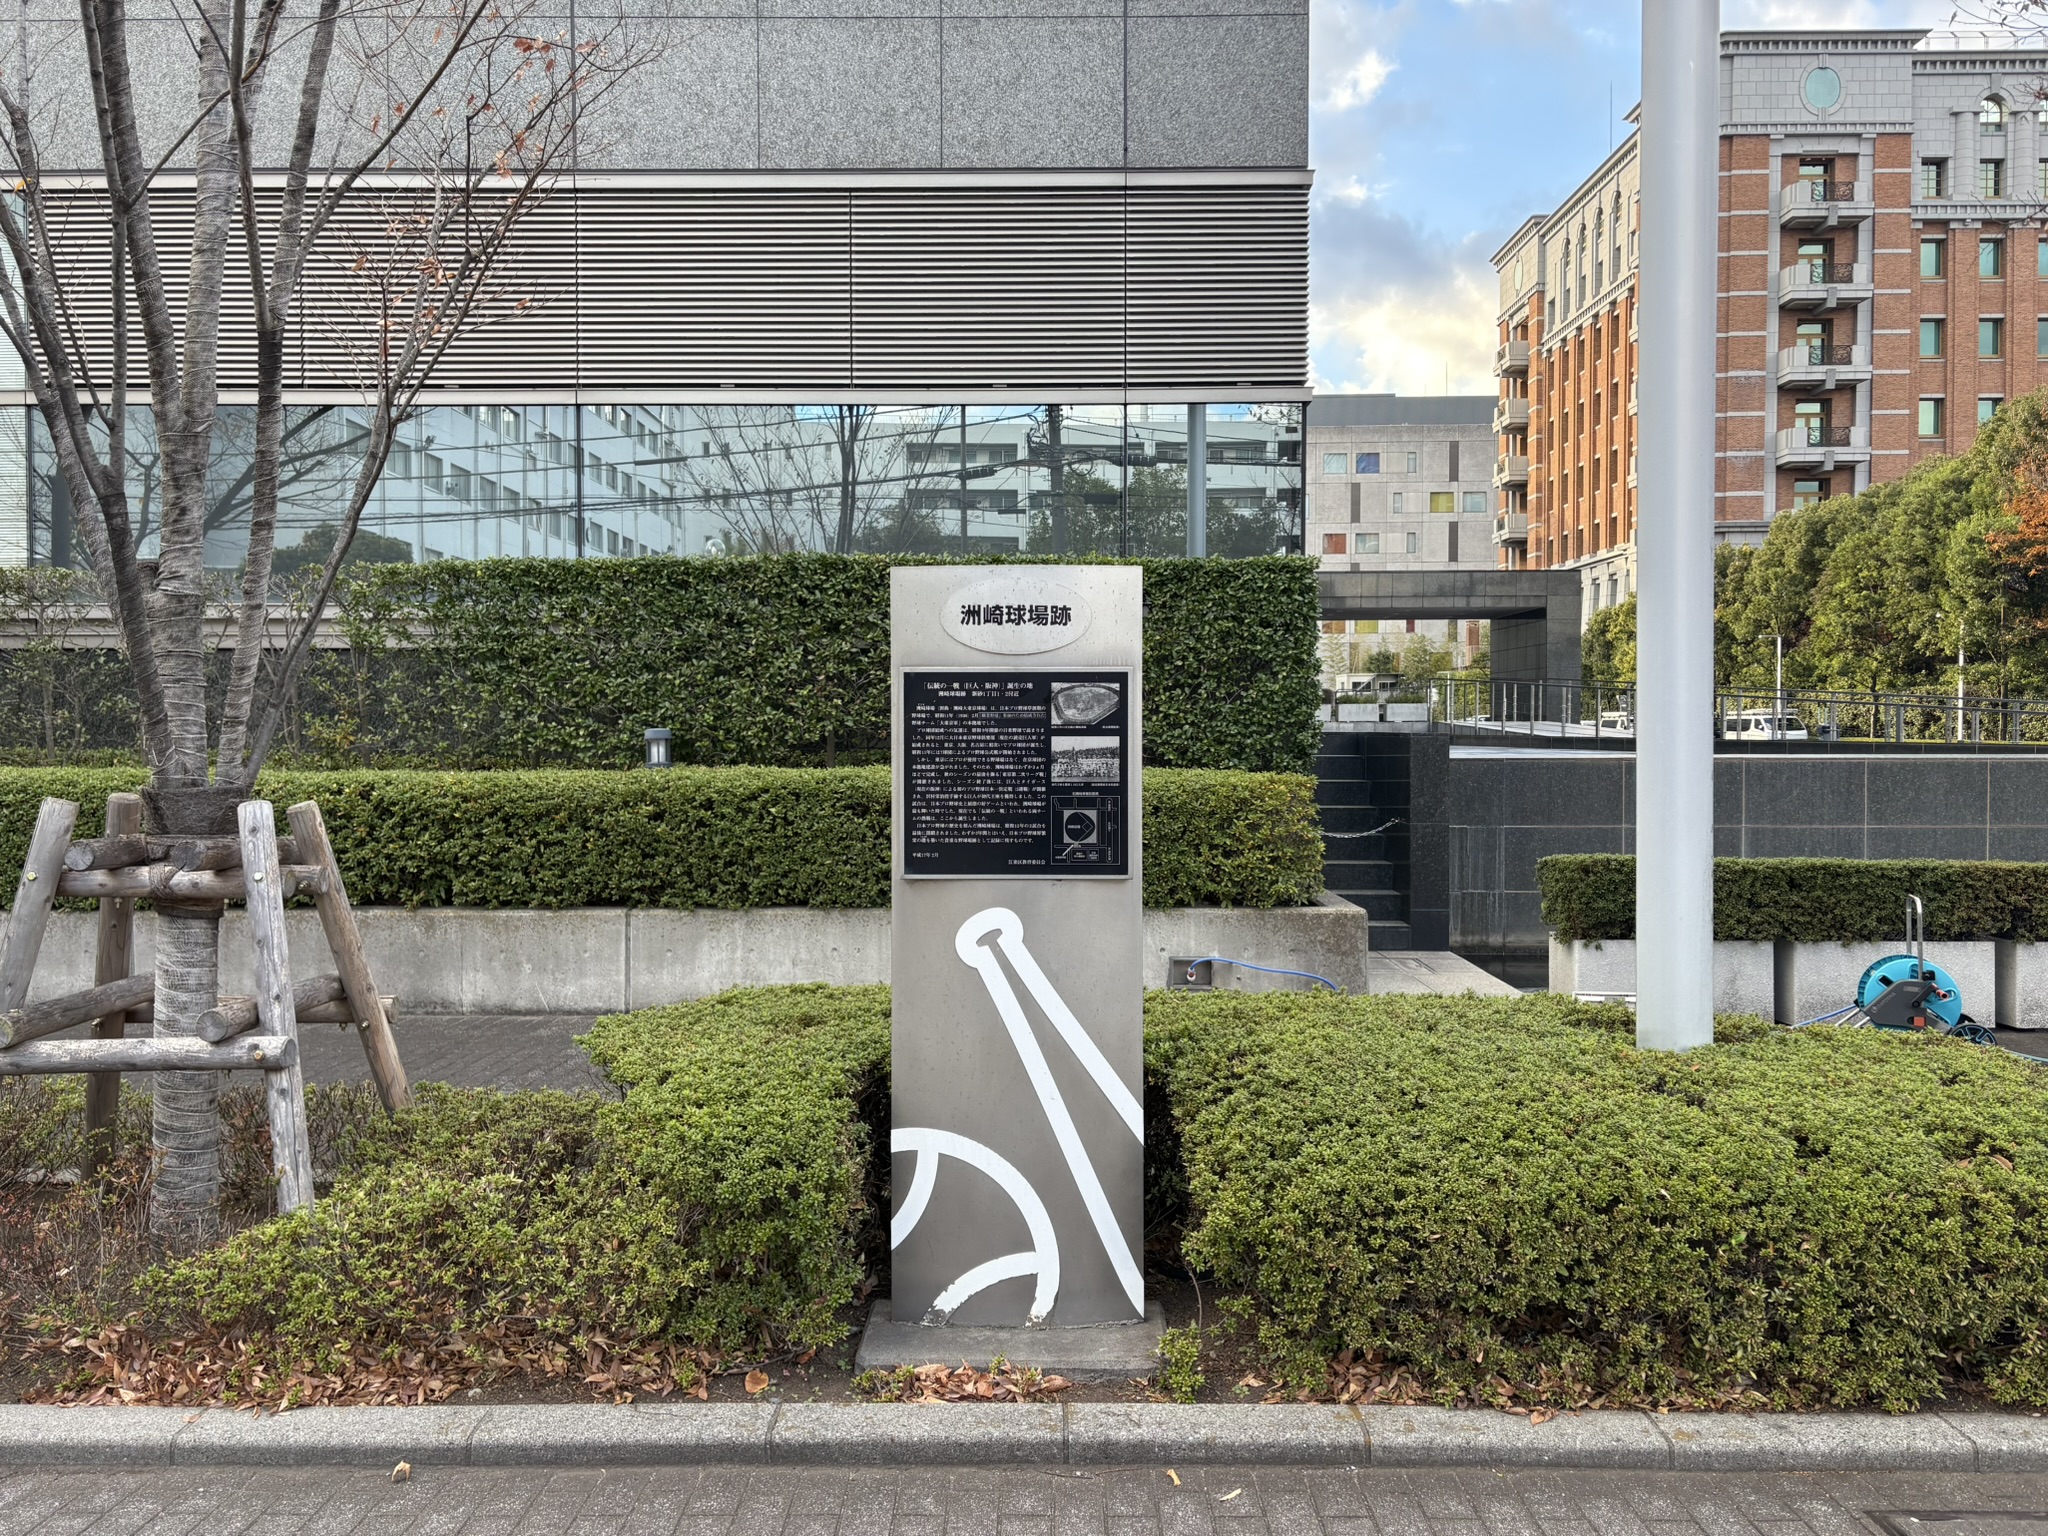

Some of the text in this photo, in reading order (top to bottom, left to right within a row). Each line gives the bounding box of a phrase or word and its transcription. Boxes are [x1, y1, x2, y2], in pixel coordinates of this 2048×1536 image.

[960, 604, 1072, 626] 洲崎球場跡
